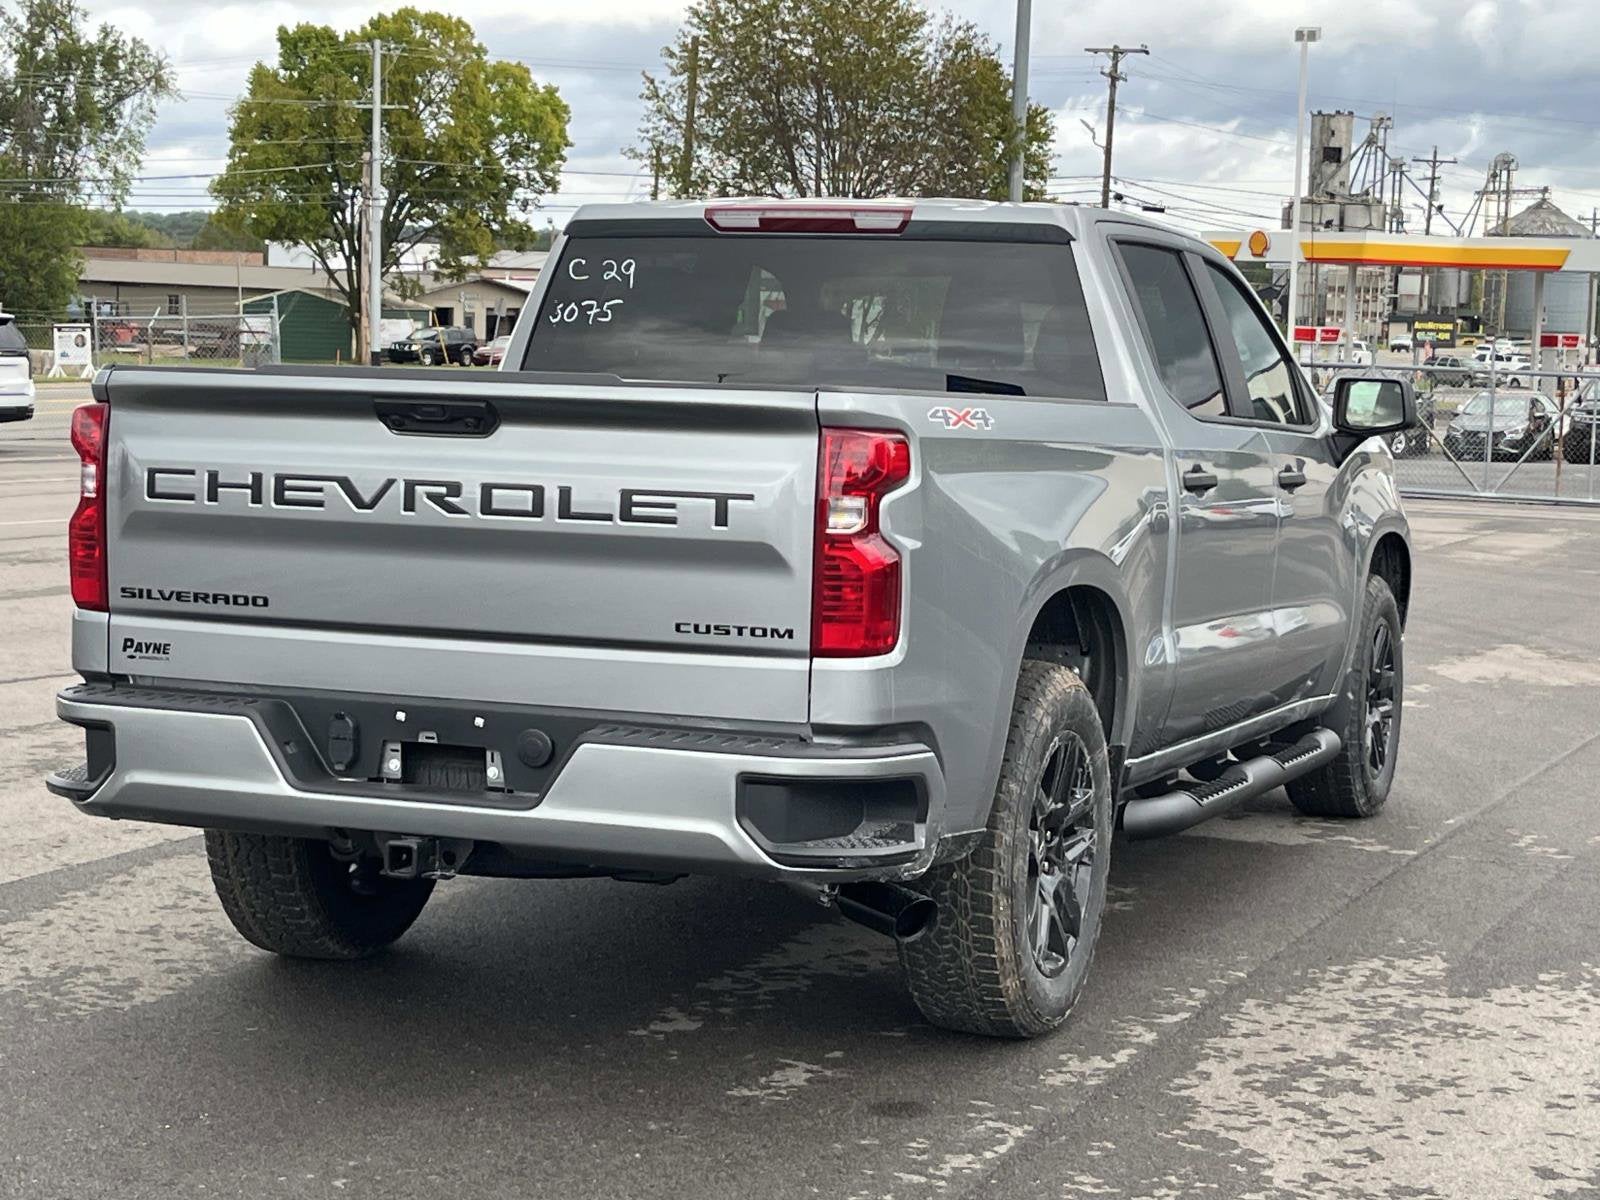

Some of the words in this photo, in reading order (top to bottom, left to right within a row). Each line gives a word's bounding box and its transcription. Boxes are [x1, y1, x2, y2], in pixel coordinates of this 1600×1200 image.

[568, 258, 590, 280] C
[602, 259, 636, 289] 29
[144, 467, 755, 530] CHEVROLET
[120, 586, 269, 608] SILVERADO
[675, 622, 794, 640] CUSTOM
[122, 637, 171, 655] PAYNE
